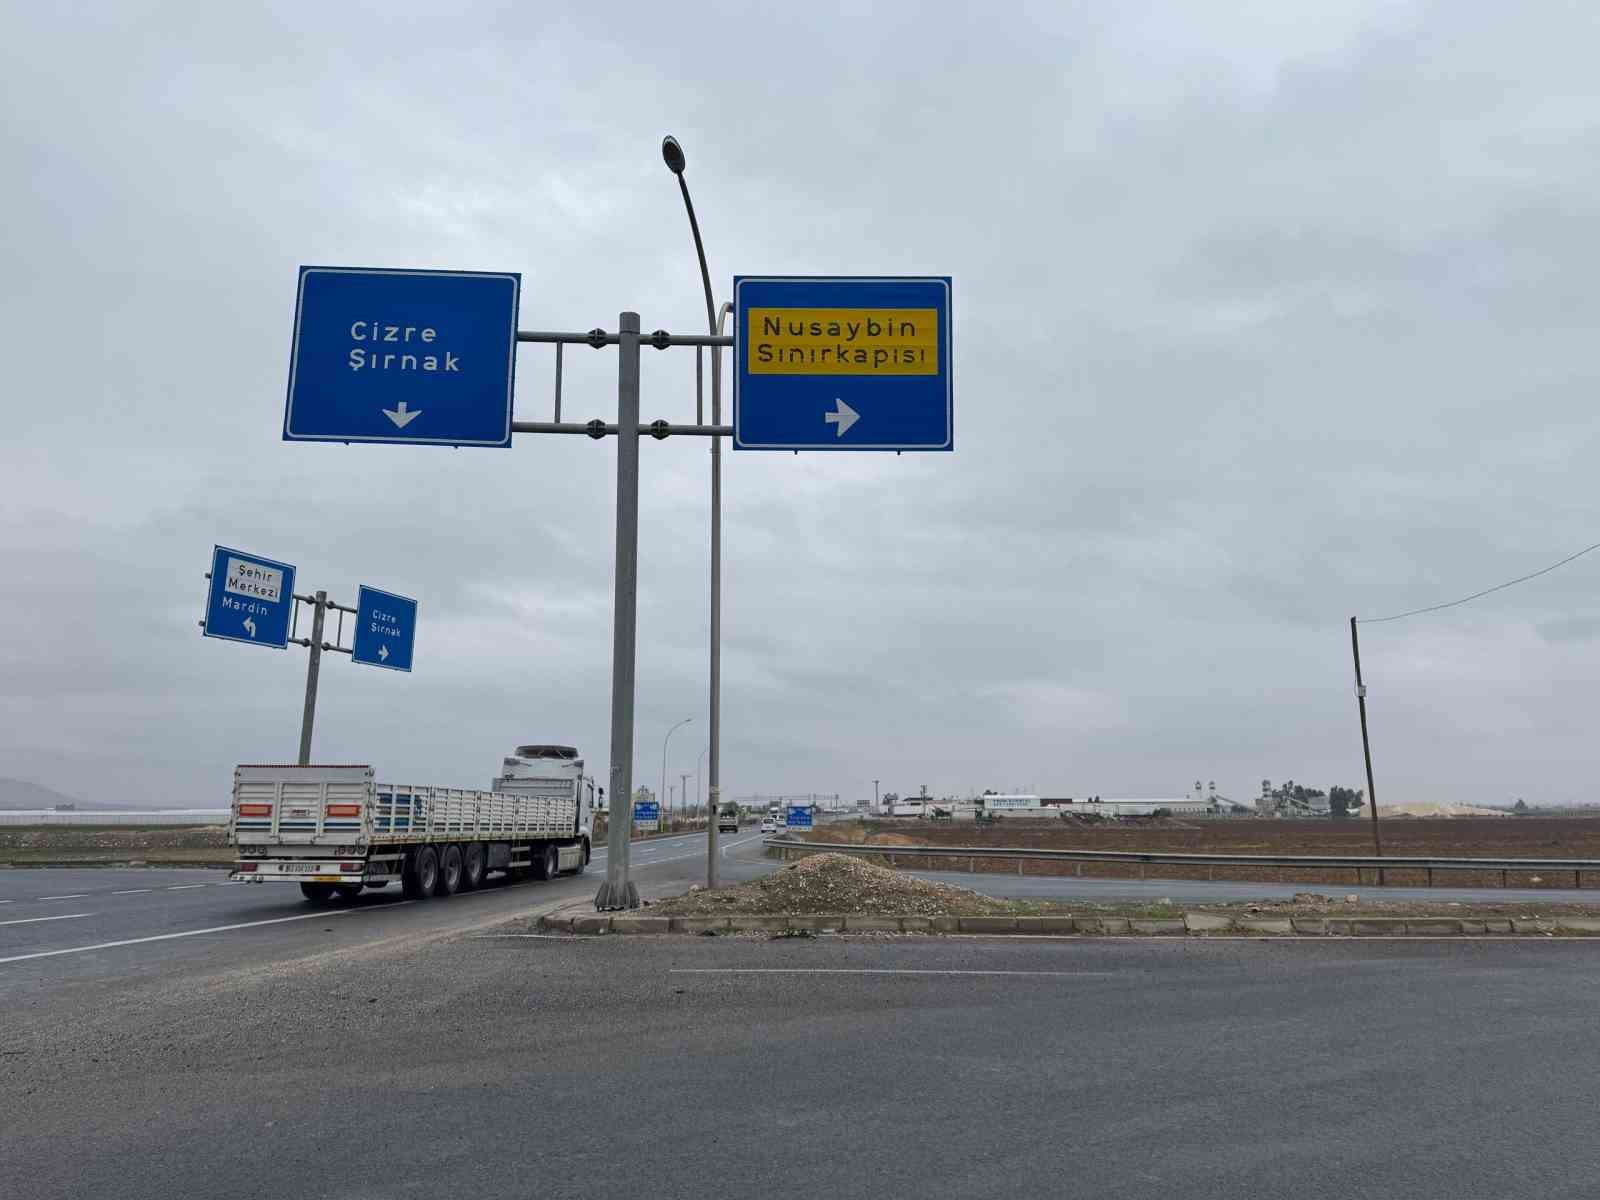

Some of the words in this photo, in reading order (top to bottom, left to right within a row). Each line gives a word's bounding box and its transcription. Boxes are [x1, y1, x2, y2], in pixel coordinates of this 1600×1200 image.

[350, 321, 437, 342] Cizre
[763, 316, 916, 341] Nusaybin
[348, 348, 460, 372] Şırnak
[758, 343, 925, 368] Sınırkapısı
[239, 564, 273, 582] Şehir
[228, 577, 279, 598] Merkezi
[222, 596, 268, 616] Mardin
[372, 609, 397, 624] Cizre
